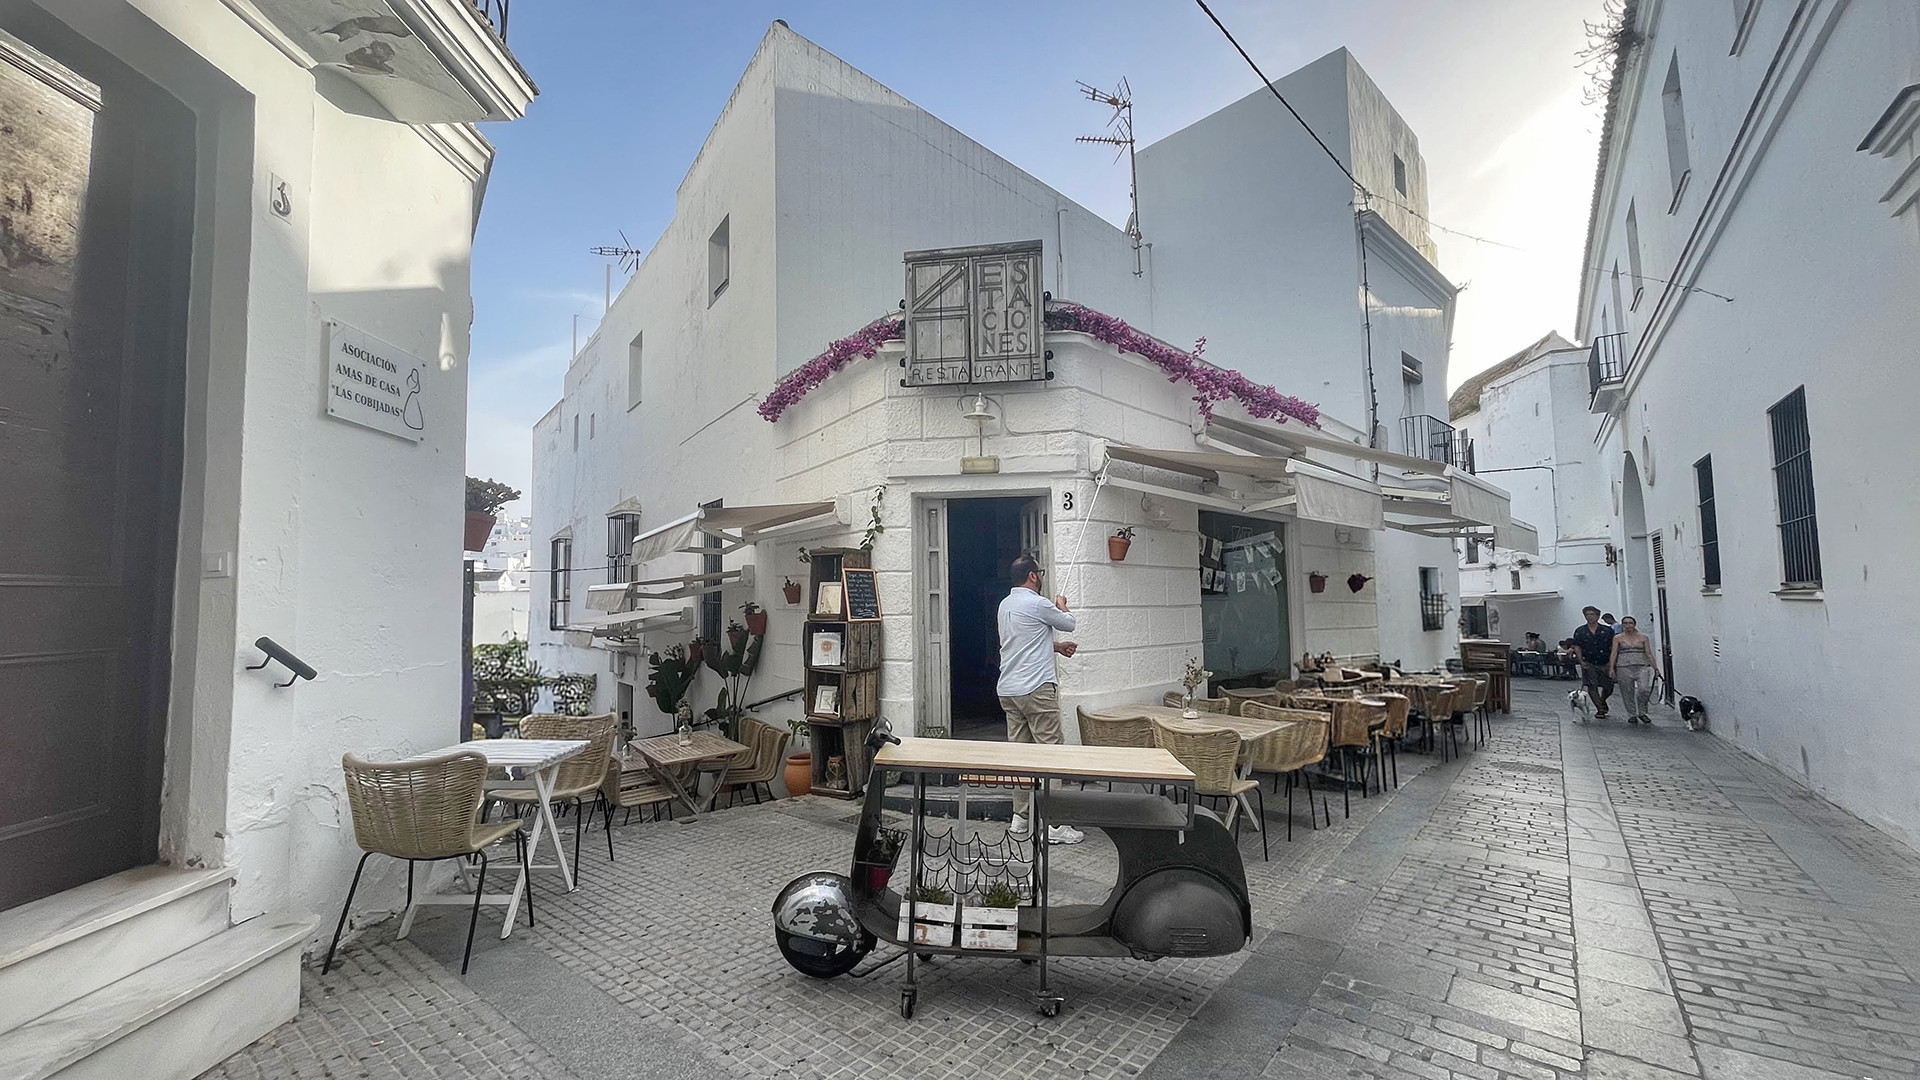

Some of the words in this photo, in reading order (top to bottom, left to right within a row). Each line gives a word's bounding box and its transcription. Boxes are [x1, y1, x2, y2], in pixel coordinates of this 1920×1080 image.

[341, 342, 397, 374] ASOCIACIÓN
[335, 363, 363, 382] AMAS
[365, 374, 377, 388] DE
[379, 380, 401, 397] CASA
[912, 363, 1041, 382] RESTAURANTE
[1063, 491, 1074, 511] 3
